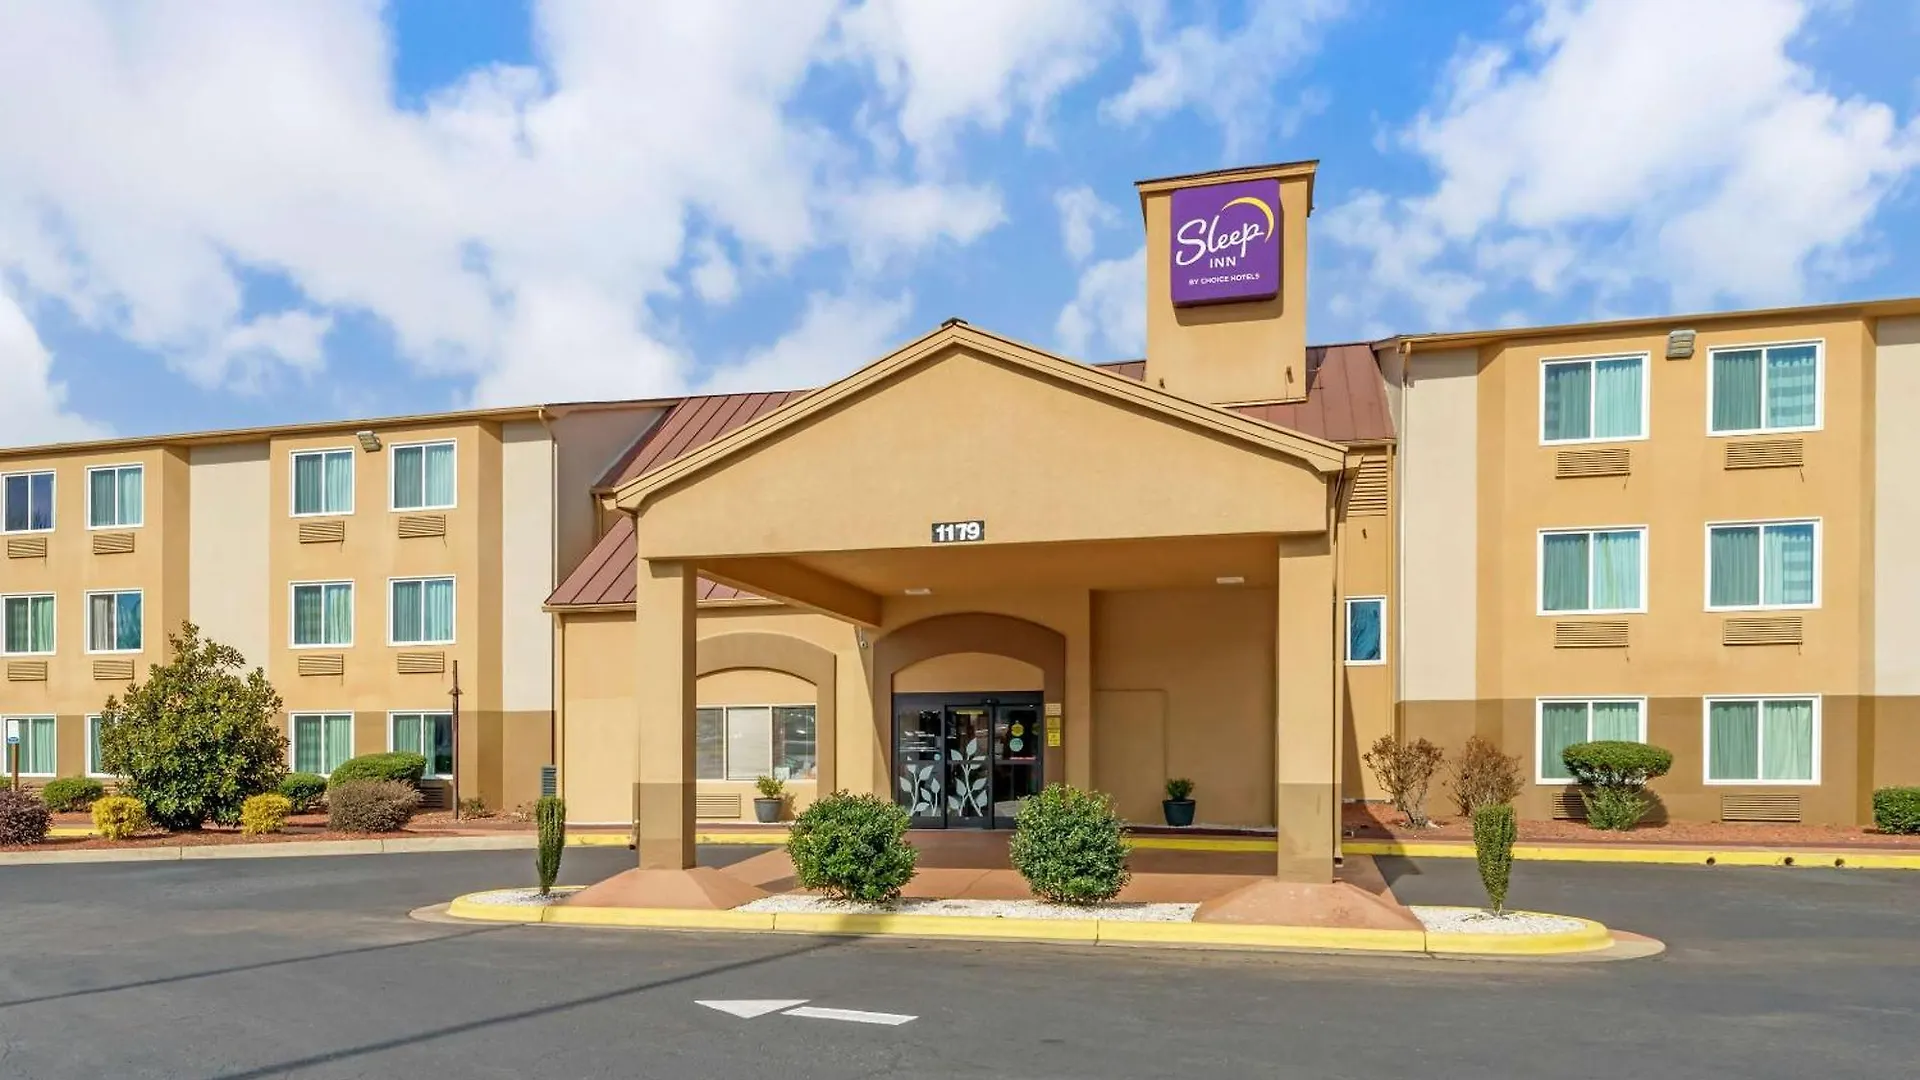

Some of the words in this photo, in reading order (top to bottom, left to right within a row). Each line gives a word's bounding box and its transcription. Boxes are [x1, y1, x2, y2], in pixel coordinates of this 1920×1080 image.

[1176, 215, 1264, 265] Sleep
[1210, 257, 1236, 268] INN
[1201, 276, 1229, 284] CHOICE
[1231, 273, 1260, 281] HOTELS
[936, 522, 980, 541] 1179
